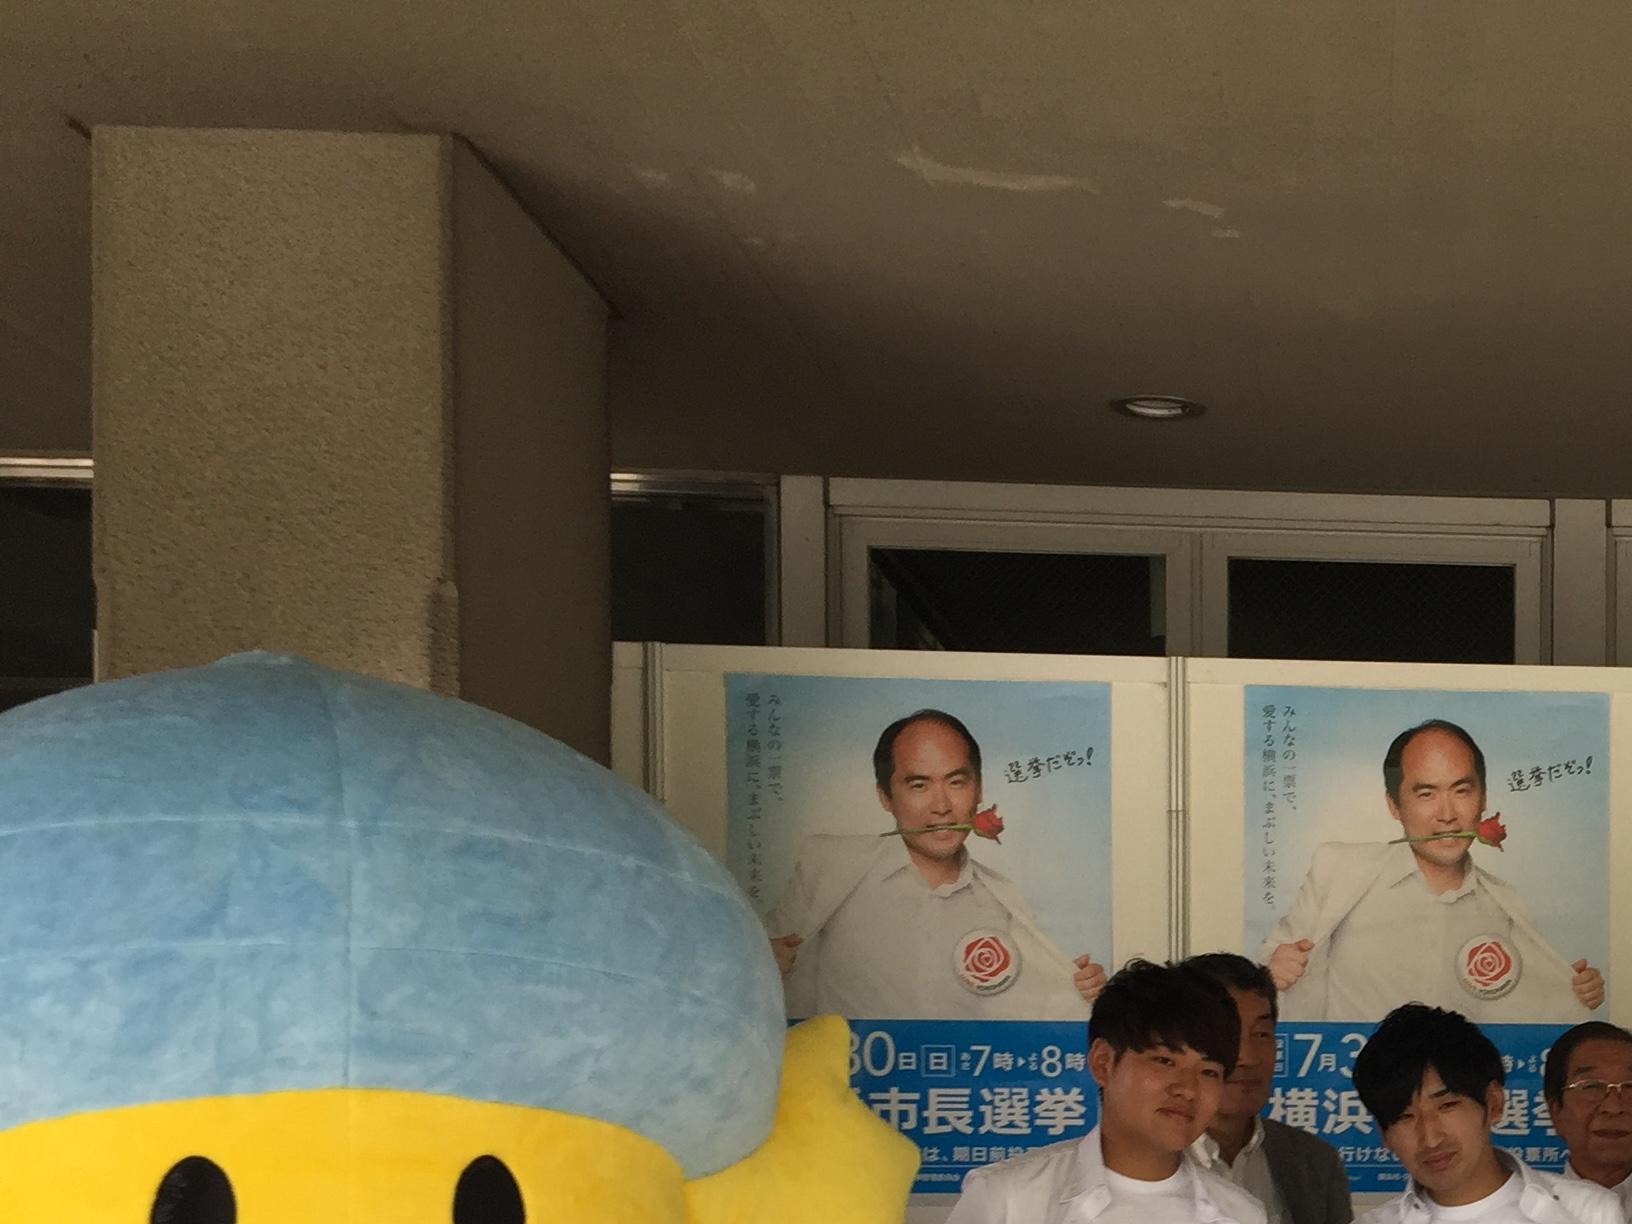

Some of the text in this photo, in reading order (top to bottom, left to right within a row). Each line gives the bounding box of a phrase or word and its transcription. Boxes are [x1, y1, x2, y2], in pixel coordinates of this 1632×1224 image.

[853, 1087, 1087, 1135] 市長選挙
[1268, 1086, 1374, 1135] 横浜
